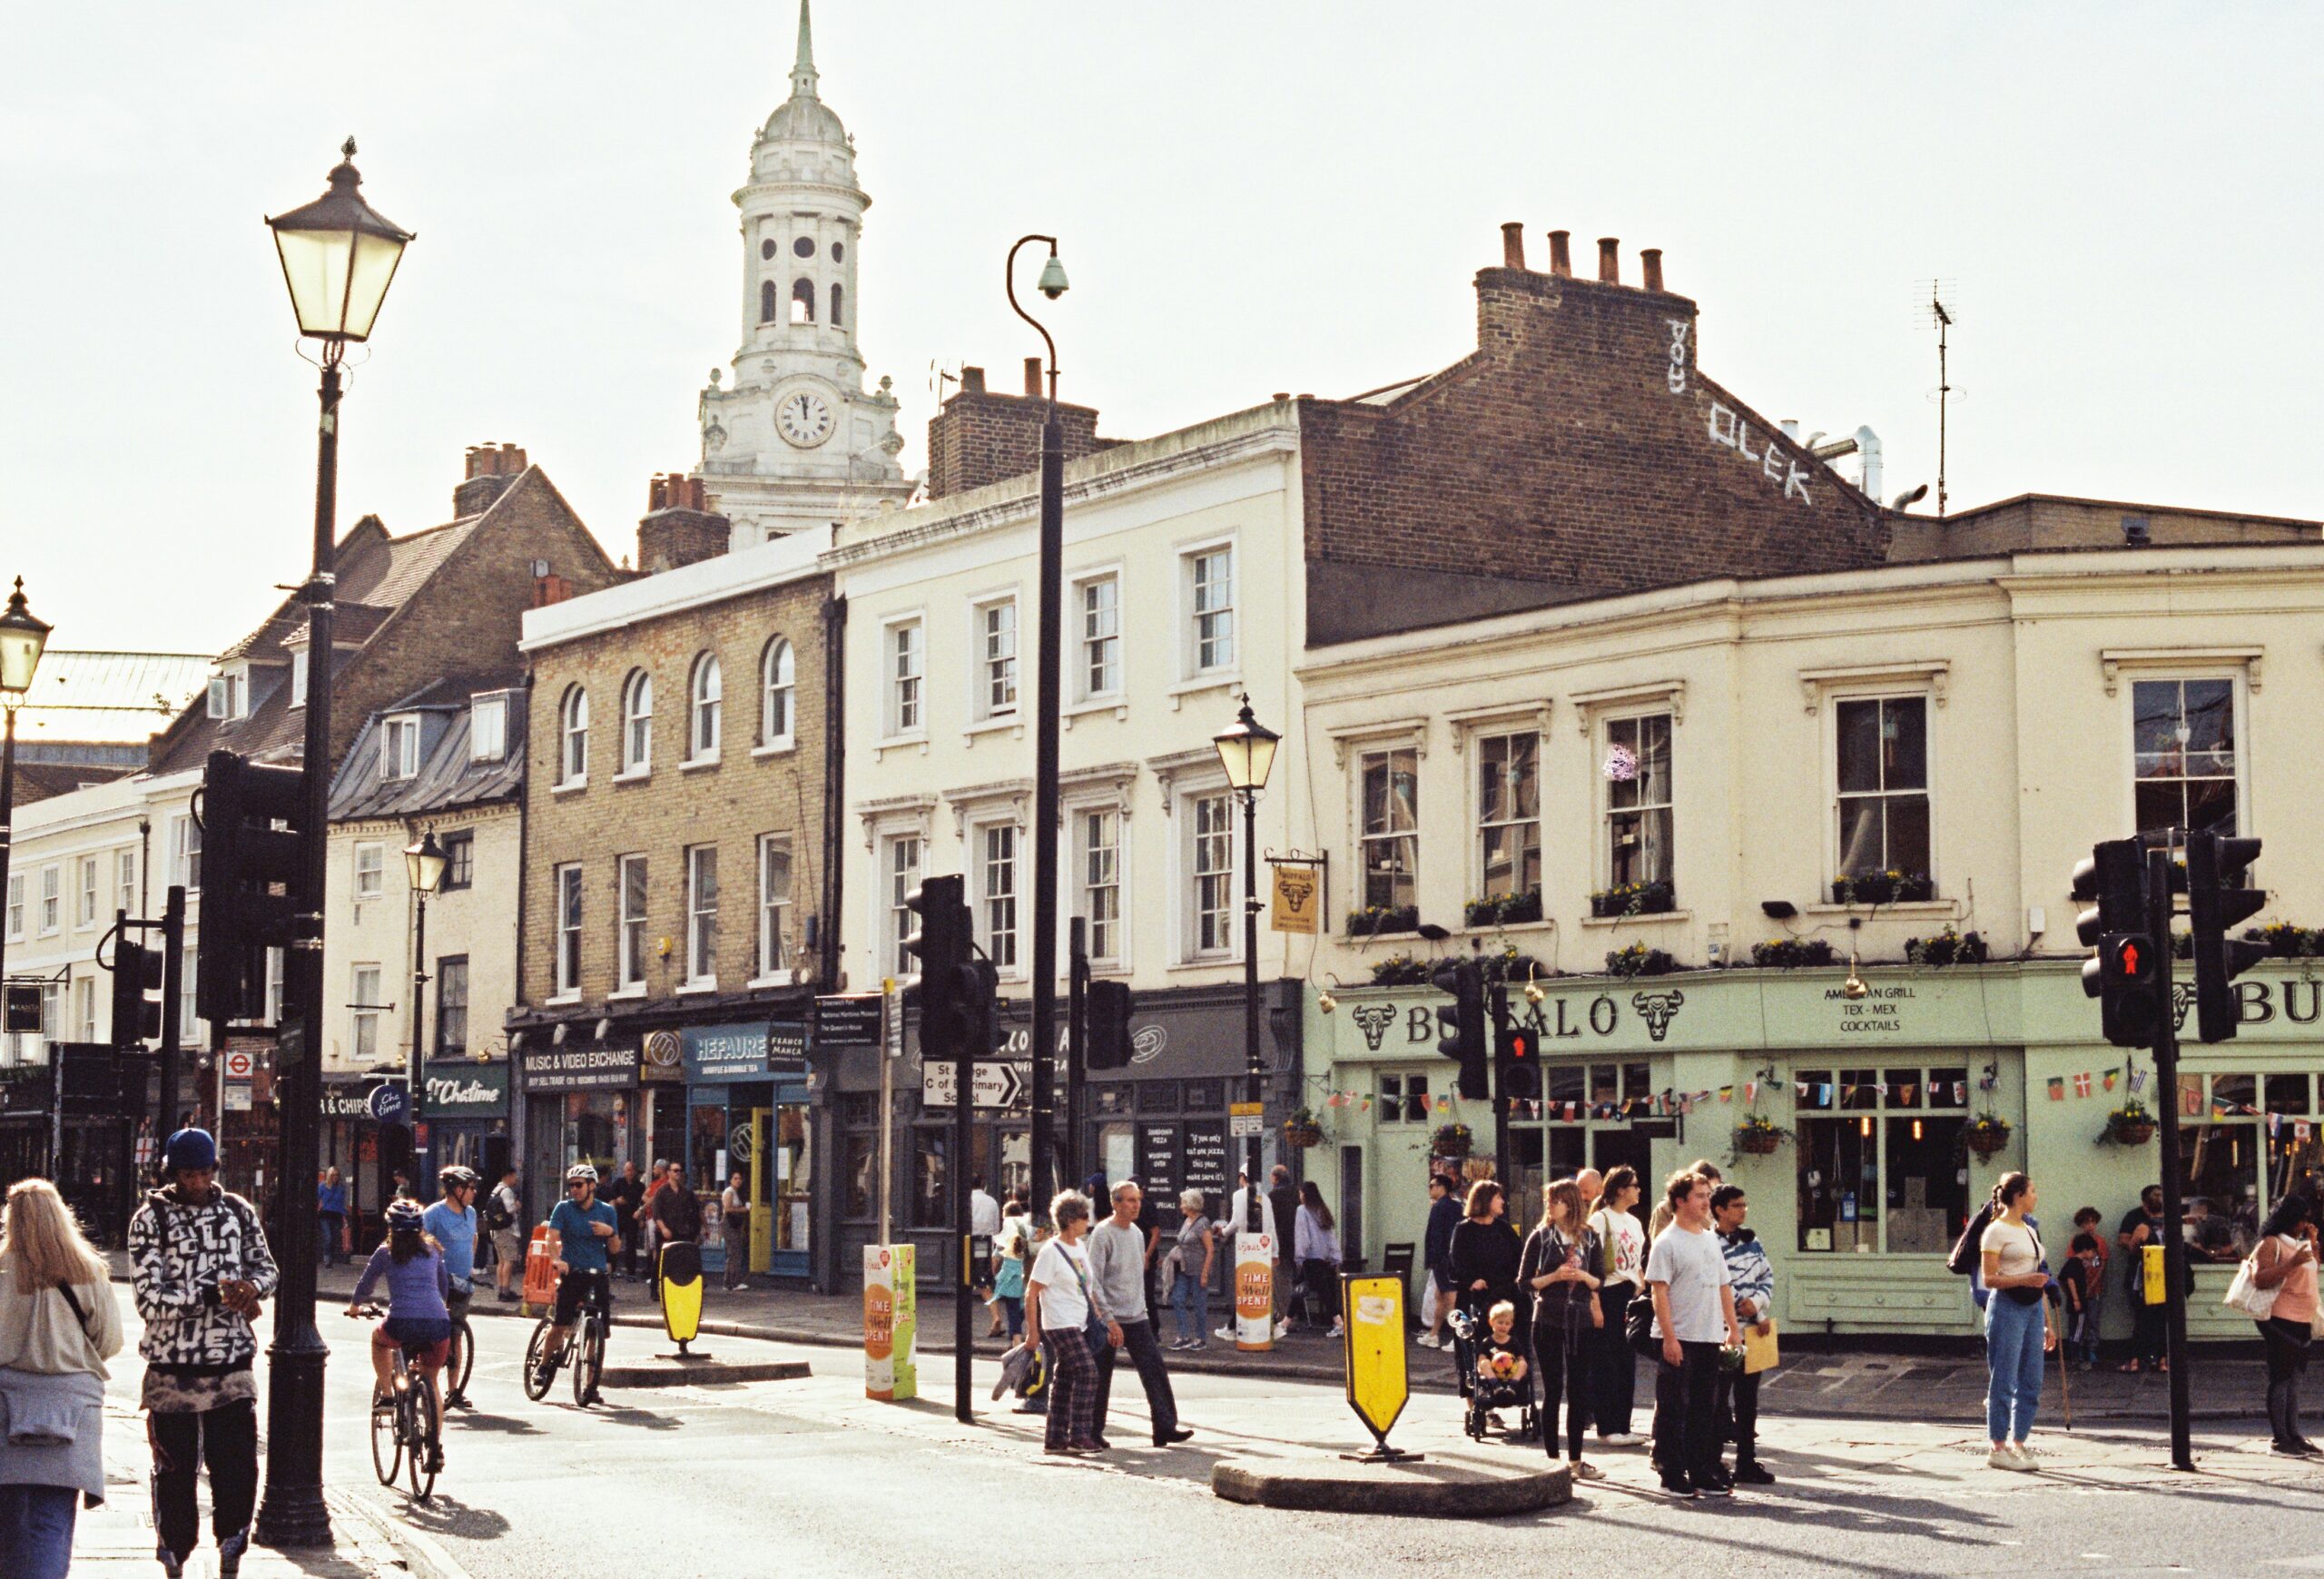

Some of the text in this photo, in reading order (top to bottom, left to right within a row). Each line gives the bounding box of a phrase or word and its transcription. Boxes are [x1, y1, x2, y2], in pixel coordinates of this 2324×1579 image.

[1709, 401, 1811, 506] OLEK
[1885, 987, 1915, 999] GRILL
[1843, 1004, 1863, 1016] TEX
[1873, 1004, 1897, 1015] MEX
[1840, 1021, 1900, 1032] COCKTAILS
[772, 1037, 803, 1045] FRANCO
[696, 1035, 767, 1061] HEFAURE
[773, 1046, 802, 1055] MANCA
[526, 1051, 635, 1071] MUSIC & VIDEO EXCHANGE
[938, 1064, 950, 1075] St
[528, 1078, 537, 1087] BUY
[538, 1077, 548, 1086] SELL
[549, 1076, 565, 1085] TRADE
[925, 1078, 934, 1089] C
[938, 1079, 949, 1089] of
[439, 1080, 500, 1104] Chatime
[381, 1092, 400, 1104] Cha
[328, 1099, 336, 1114] &
[338, 1099, 369, 1114] CHIPS
[377, 1100, 401, 1116] time
[1198, 1135, 1208, 1143] you
[1209, 1133, 1221, 1143] only
[1207, 1148, 1225, 1157] pizza
[1192, 1160, 1203, 1168] this
[1244, 1273, 1268, 1283] TIME
[1242, 1285, 1270, 1296] Well
[869, 1299, 891, 1313] TIME
[1236, 1296, 1268, 1306] SPENT
[869, 1315, 891, 1329] Well
[865, 1329, 891, 1341] SPENT
